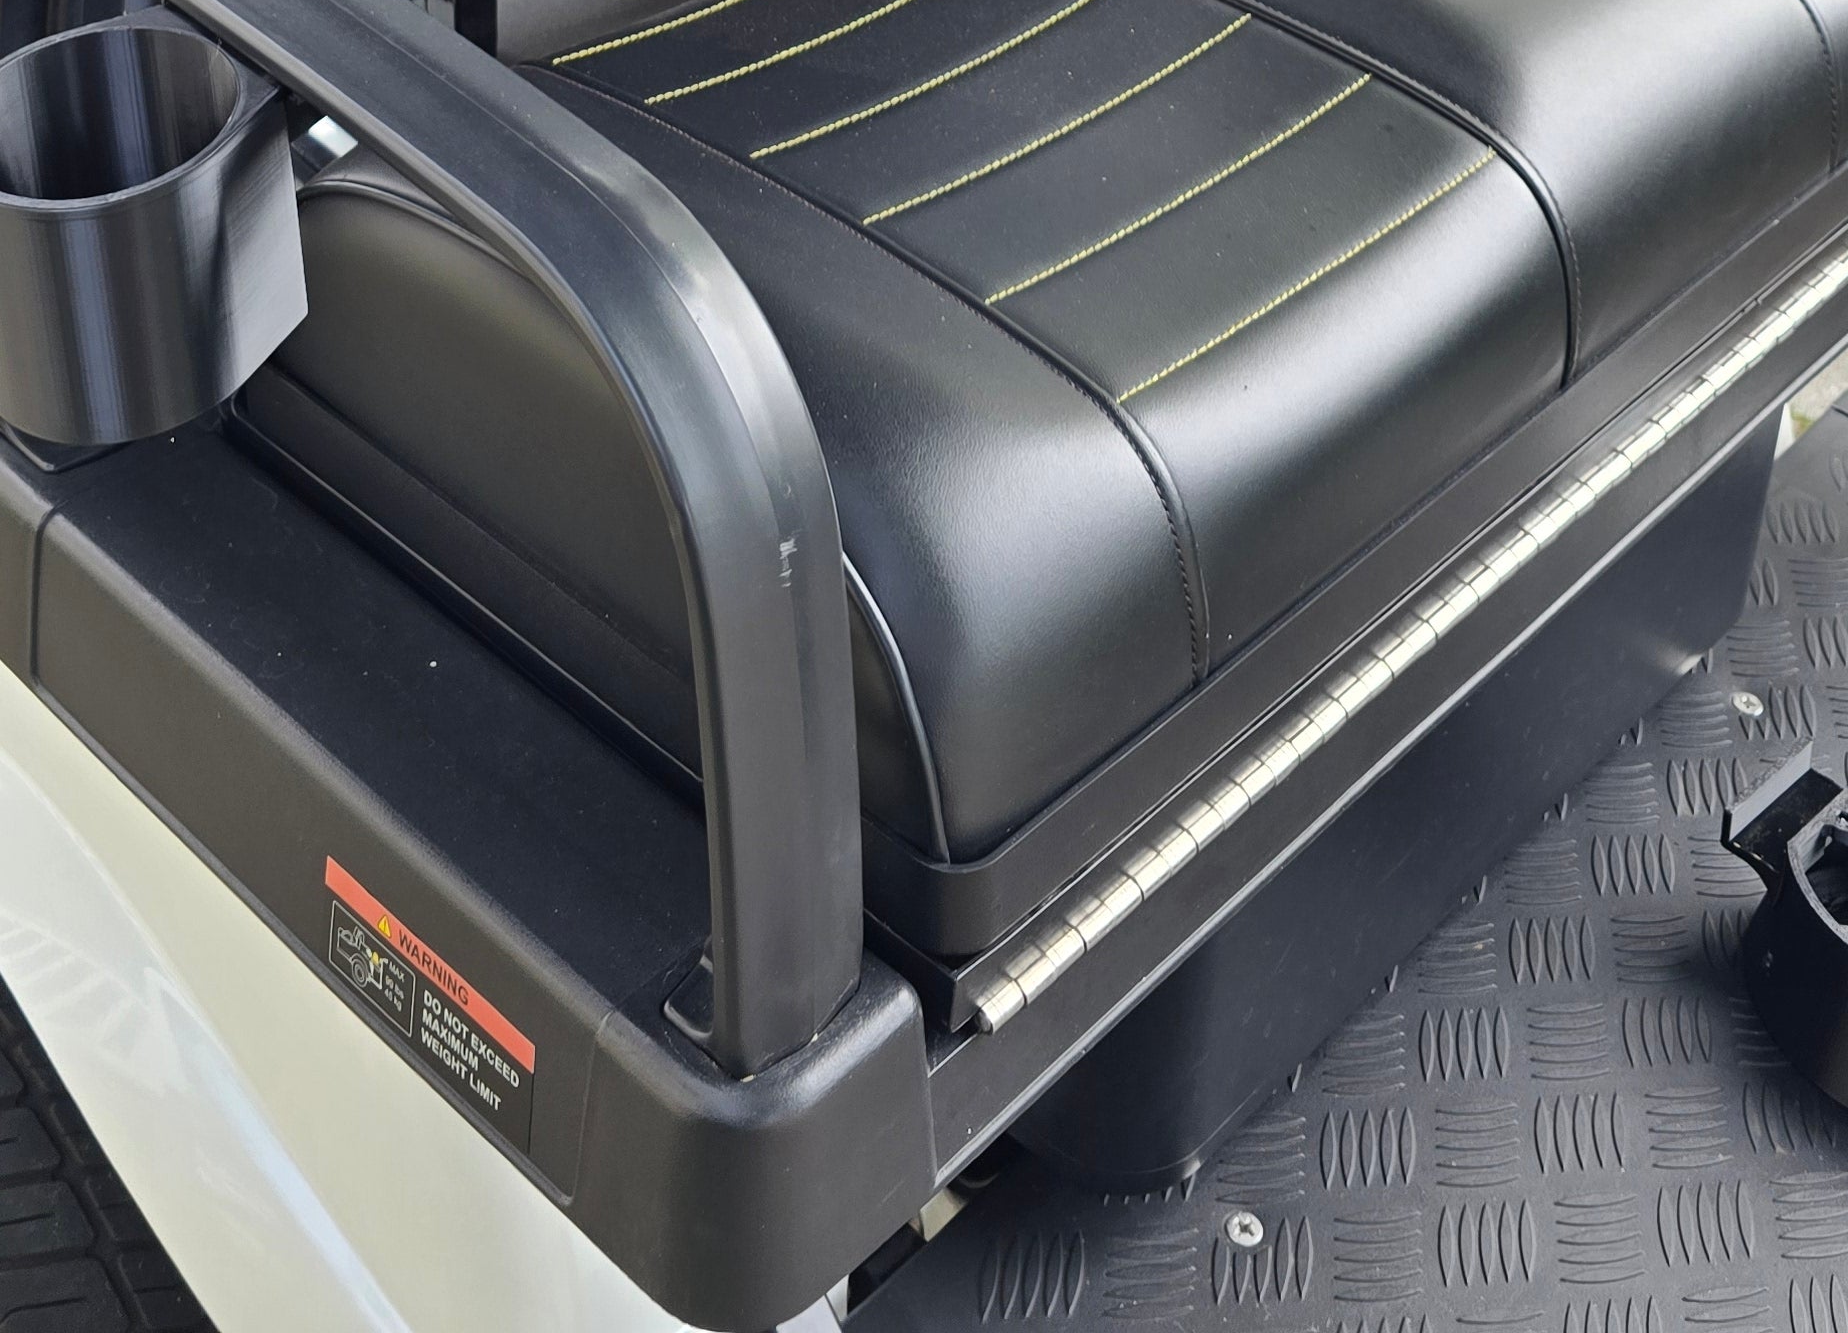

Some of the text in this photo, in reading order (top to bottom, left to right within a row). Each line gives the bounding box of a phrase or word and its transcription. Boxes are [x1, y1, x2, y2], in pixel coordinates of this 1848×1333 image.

[389, 961, 405, 983] MAX
[398, 928, 470, 1006] WARNING
[421, 1027, 501, 1110] WEIGHT LIMIT
[422, 1008, 478, 1071] MAXIMUM
[423, 989, 519, 1087] DO NOT EXCEED
